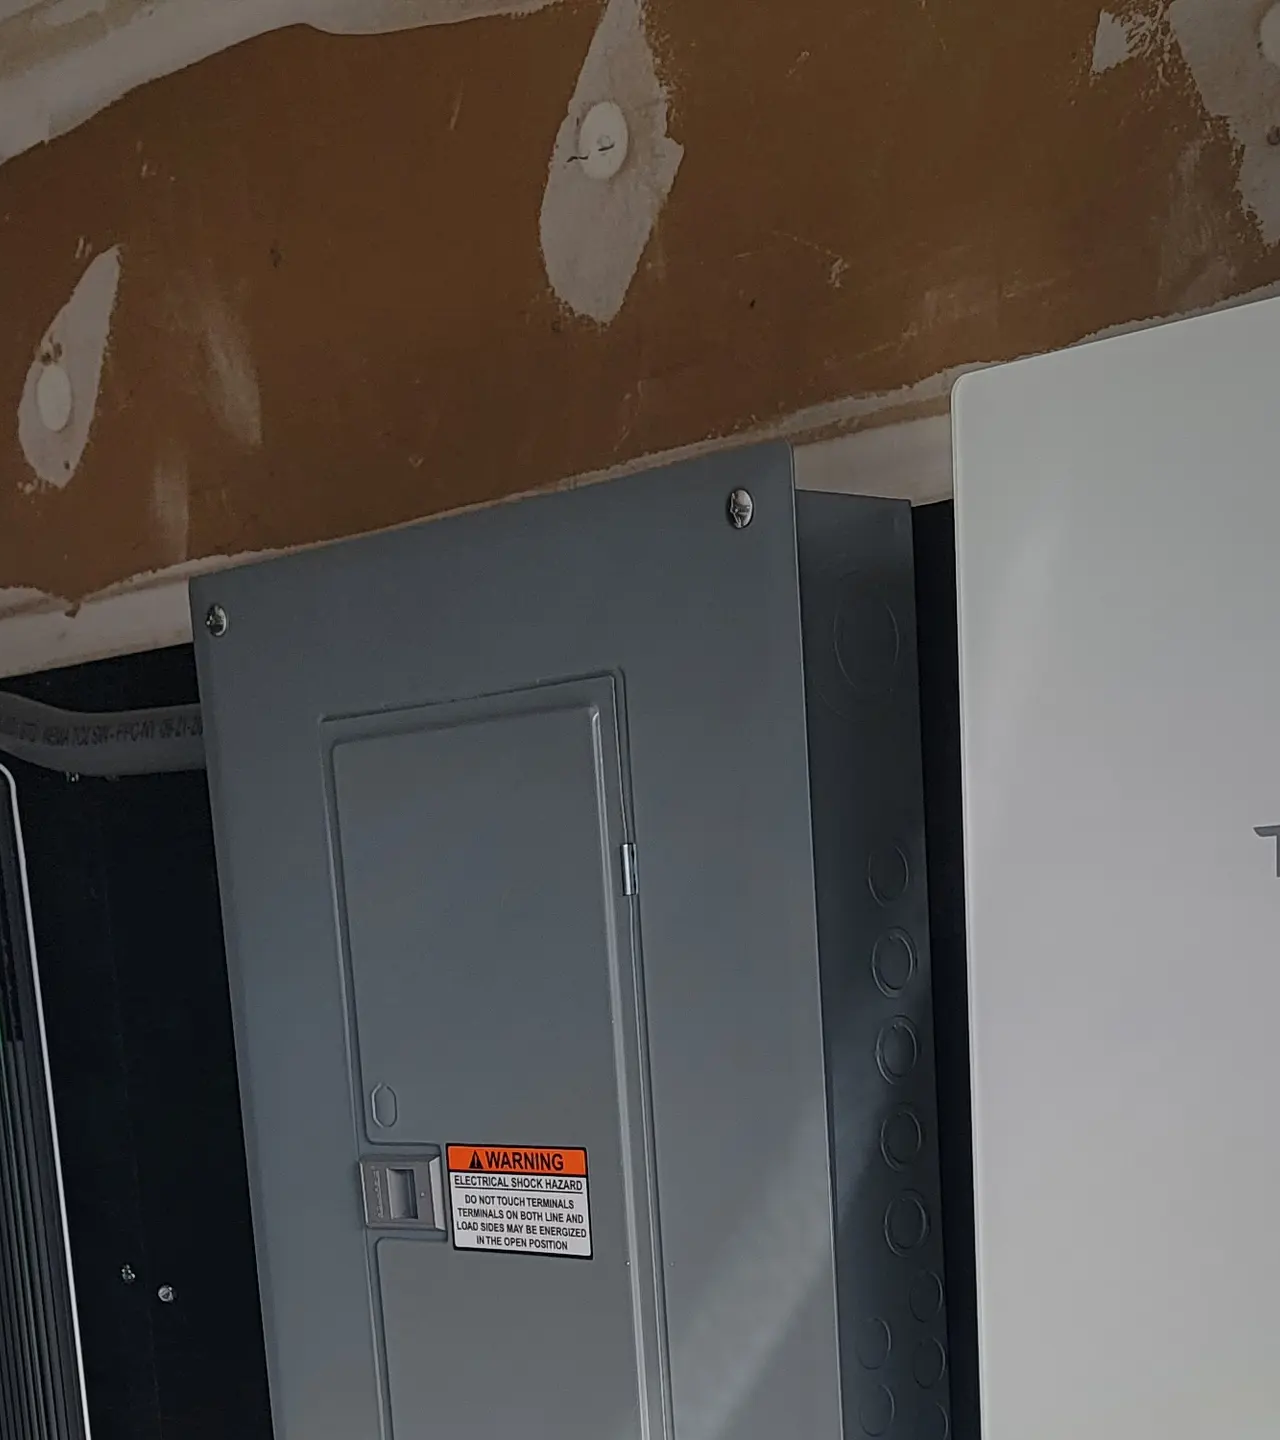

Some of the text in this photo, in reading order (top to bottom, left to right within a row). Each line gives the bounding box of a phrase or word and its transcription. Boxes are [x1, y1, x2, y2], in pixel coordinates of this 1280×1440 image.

[485, 1151, 564, 1171] WARNING
[454, 1175, 582, 1190] ELECTRICAL SHOCK HAZARD
[465, 1194, 574, 1209] DO NOT TOUCH TERMINALS
[458, 1208, 583, 1223] TERMINALS ON BOTH LINE AND
[457, 1221, 586, 1238] LOAD SIDES MAY BE ENERGIZED
[477, 1235, 568, 1250] IN THE OPEN POSITION
